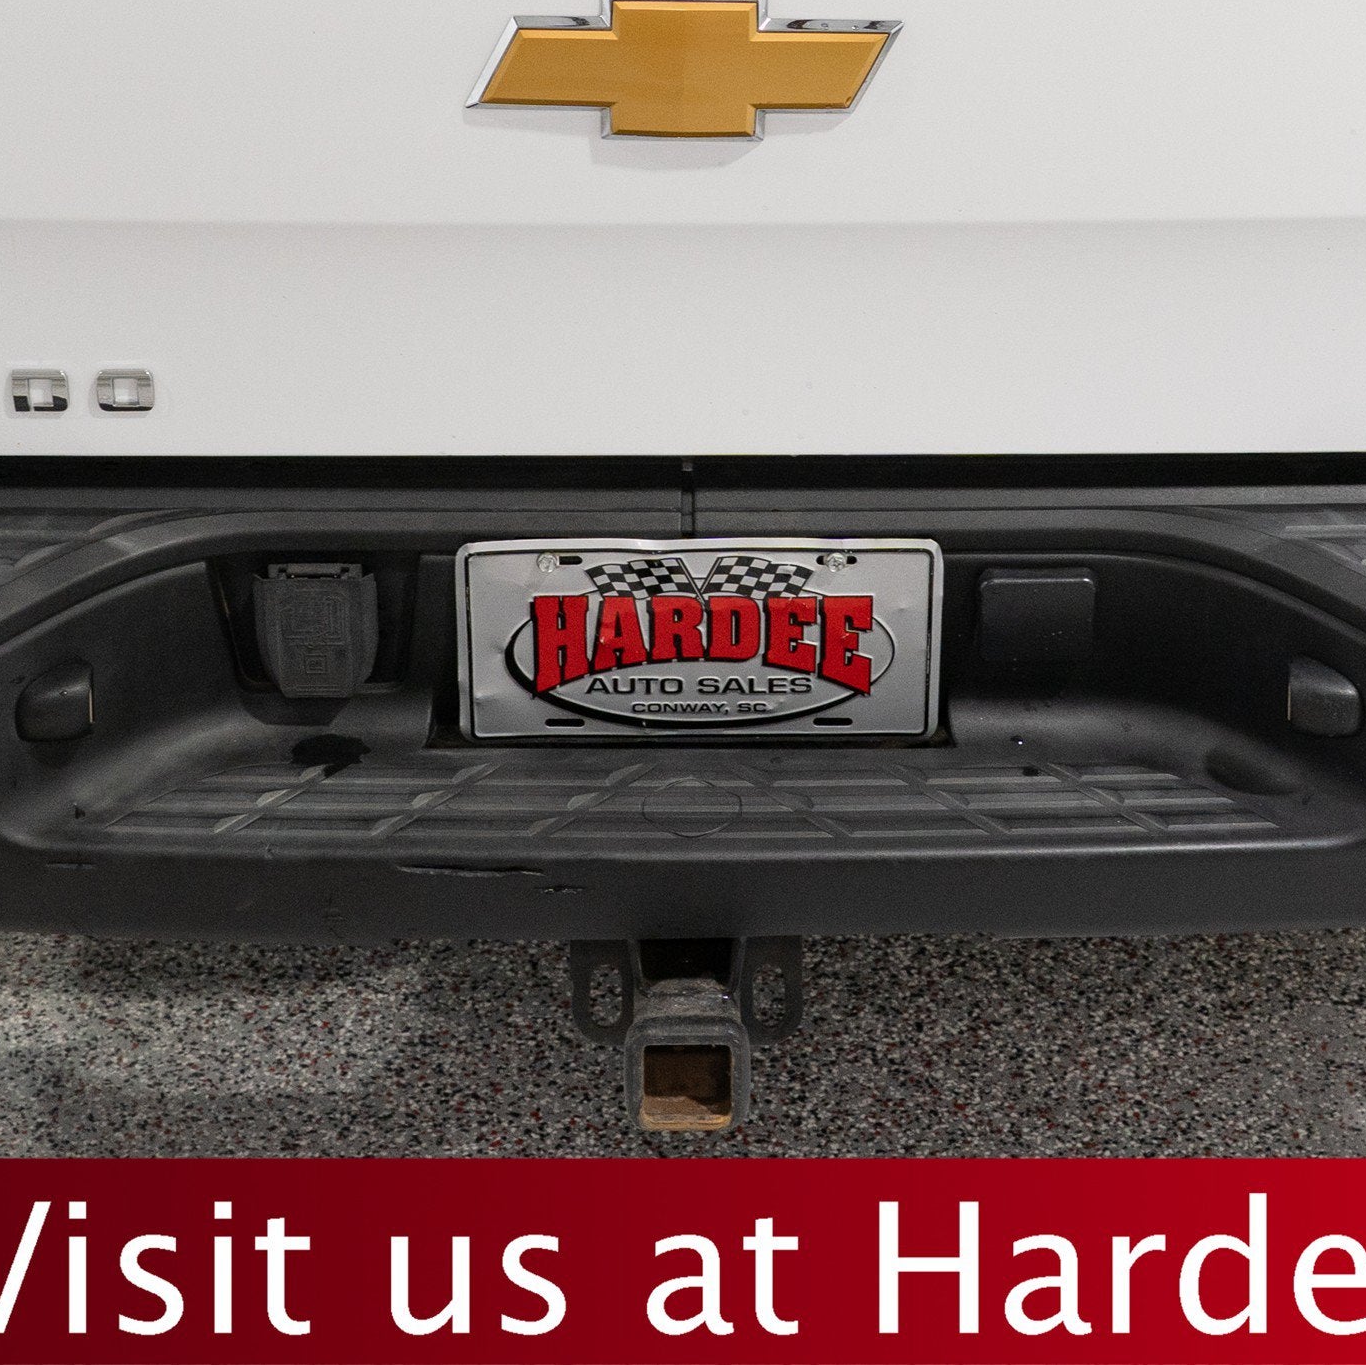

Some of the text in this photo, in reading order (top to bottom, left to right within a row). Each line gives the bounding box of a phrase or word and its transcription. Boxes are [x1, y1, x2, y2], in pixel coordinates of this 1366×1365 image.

[531, 593, 875, 698] HARDEE
[584, 676, 813, 695] AUTO SALES
[631, 701, 769, 715] CONWAY, SC
